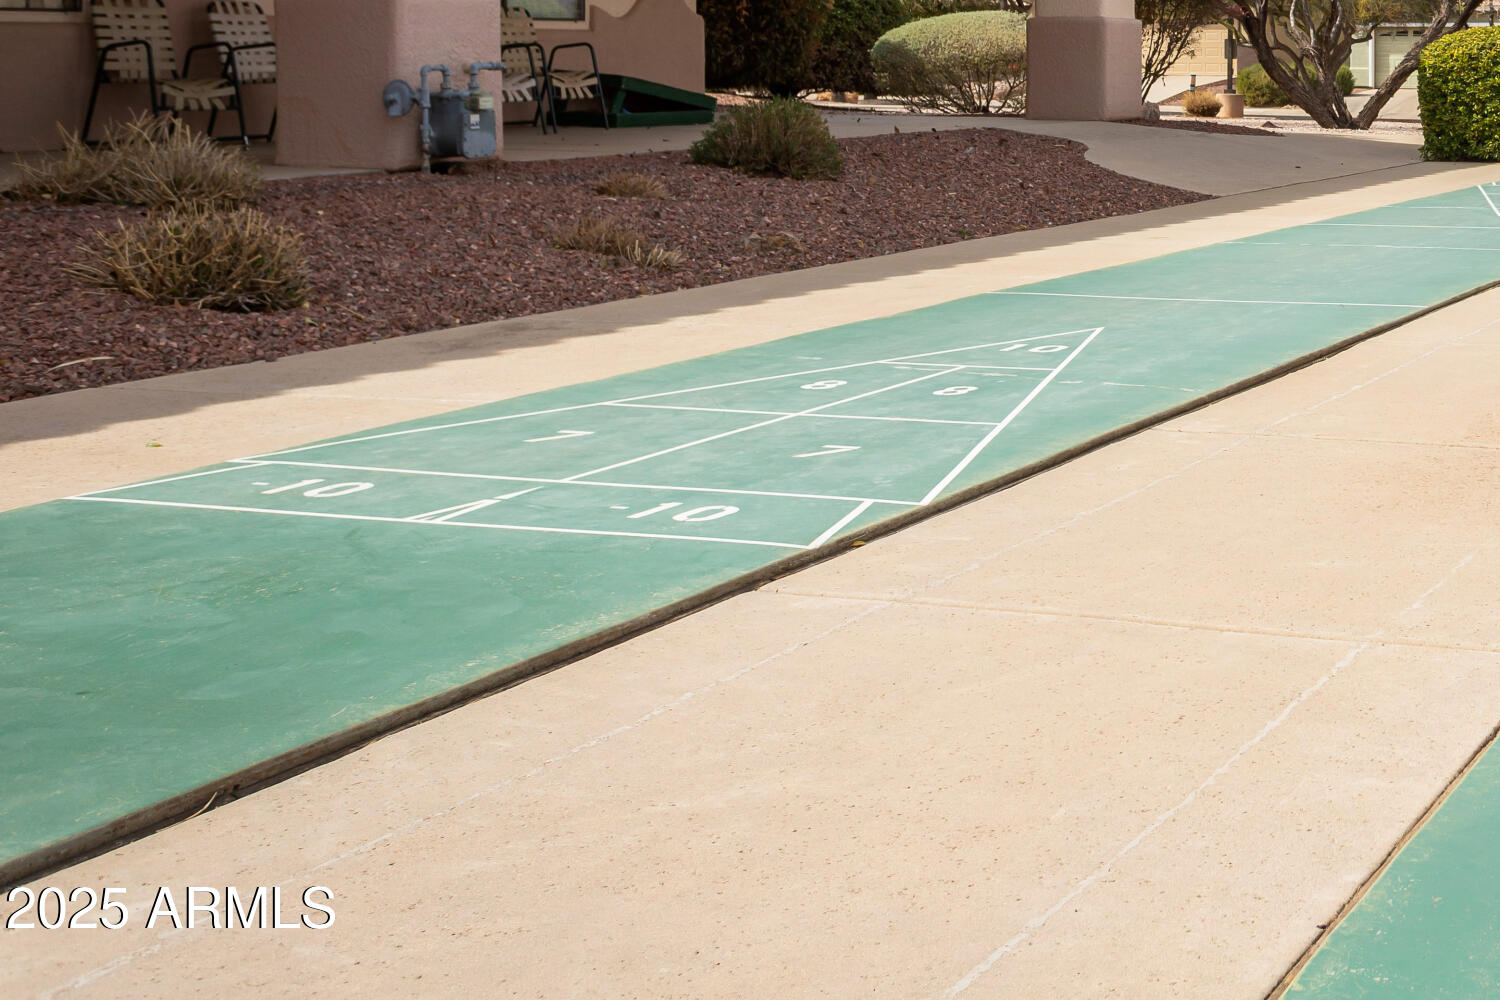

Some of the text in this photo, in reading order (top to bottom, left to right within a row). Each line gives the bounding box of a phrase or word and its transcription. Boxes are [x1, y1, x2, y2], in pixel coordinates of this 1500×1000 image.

[999, 343, 1070, 353] 10
[800, 379, 848, 390] 8
[932, 385, 979, 396] 8
[523, 429, 596, 443] 7
[791, 444, 862, 458] 7
